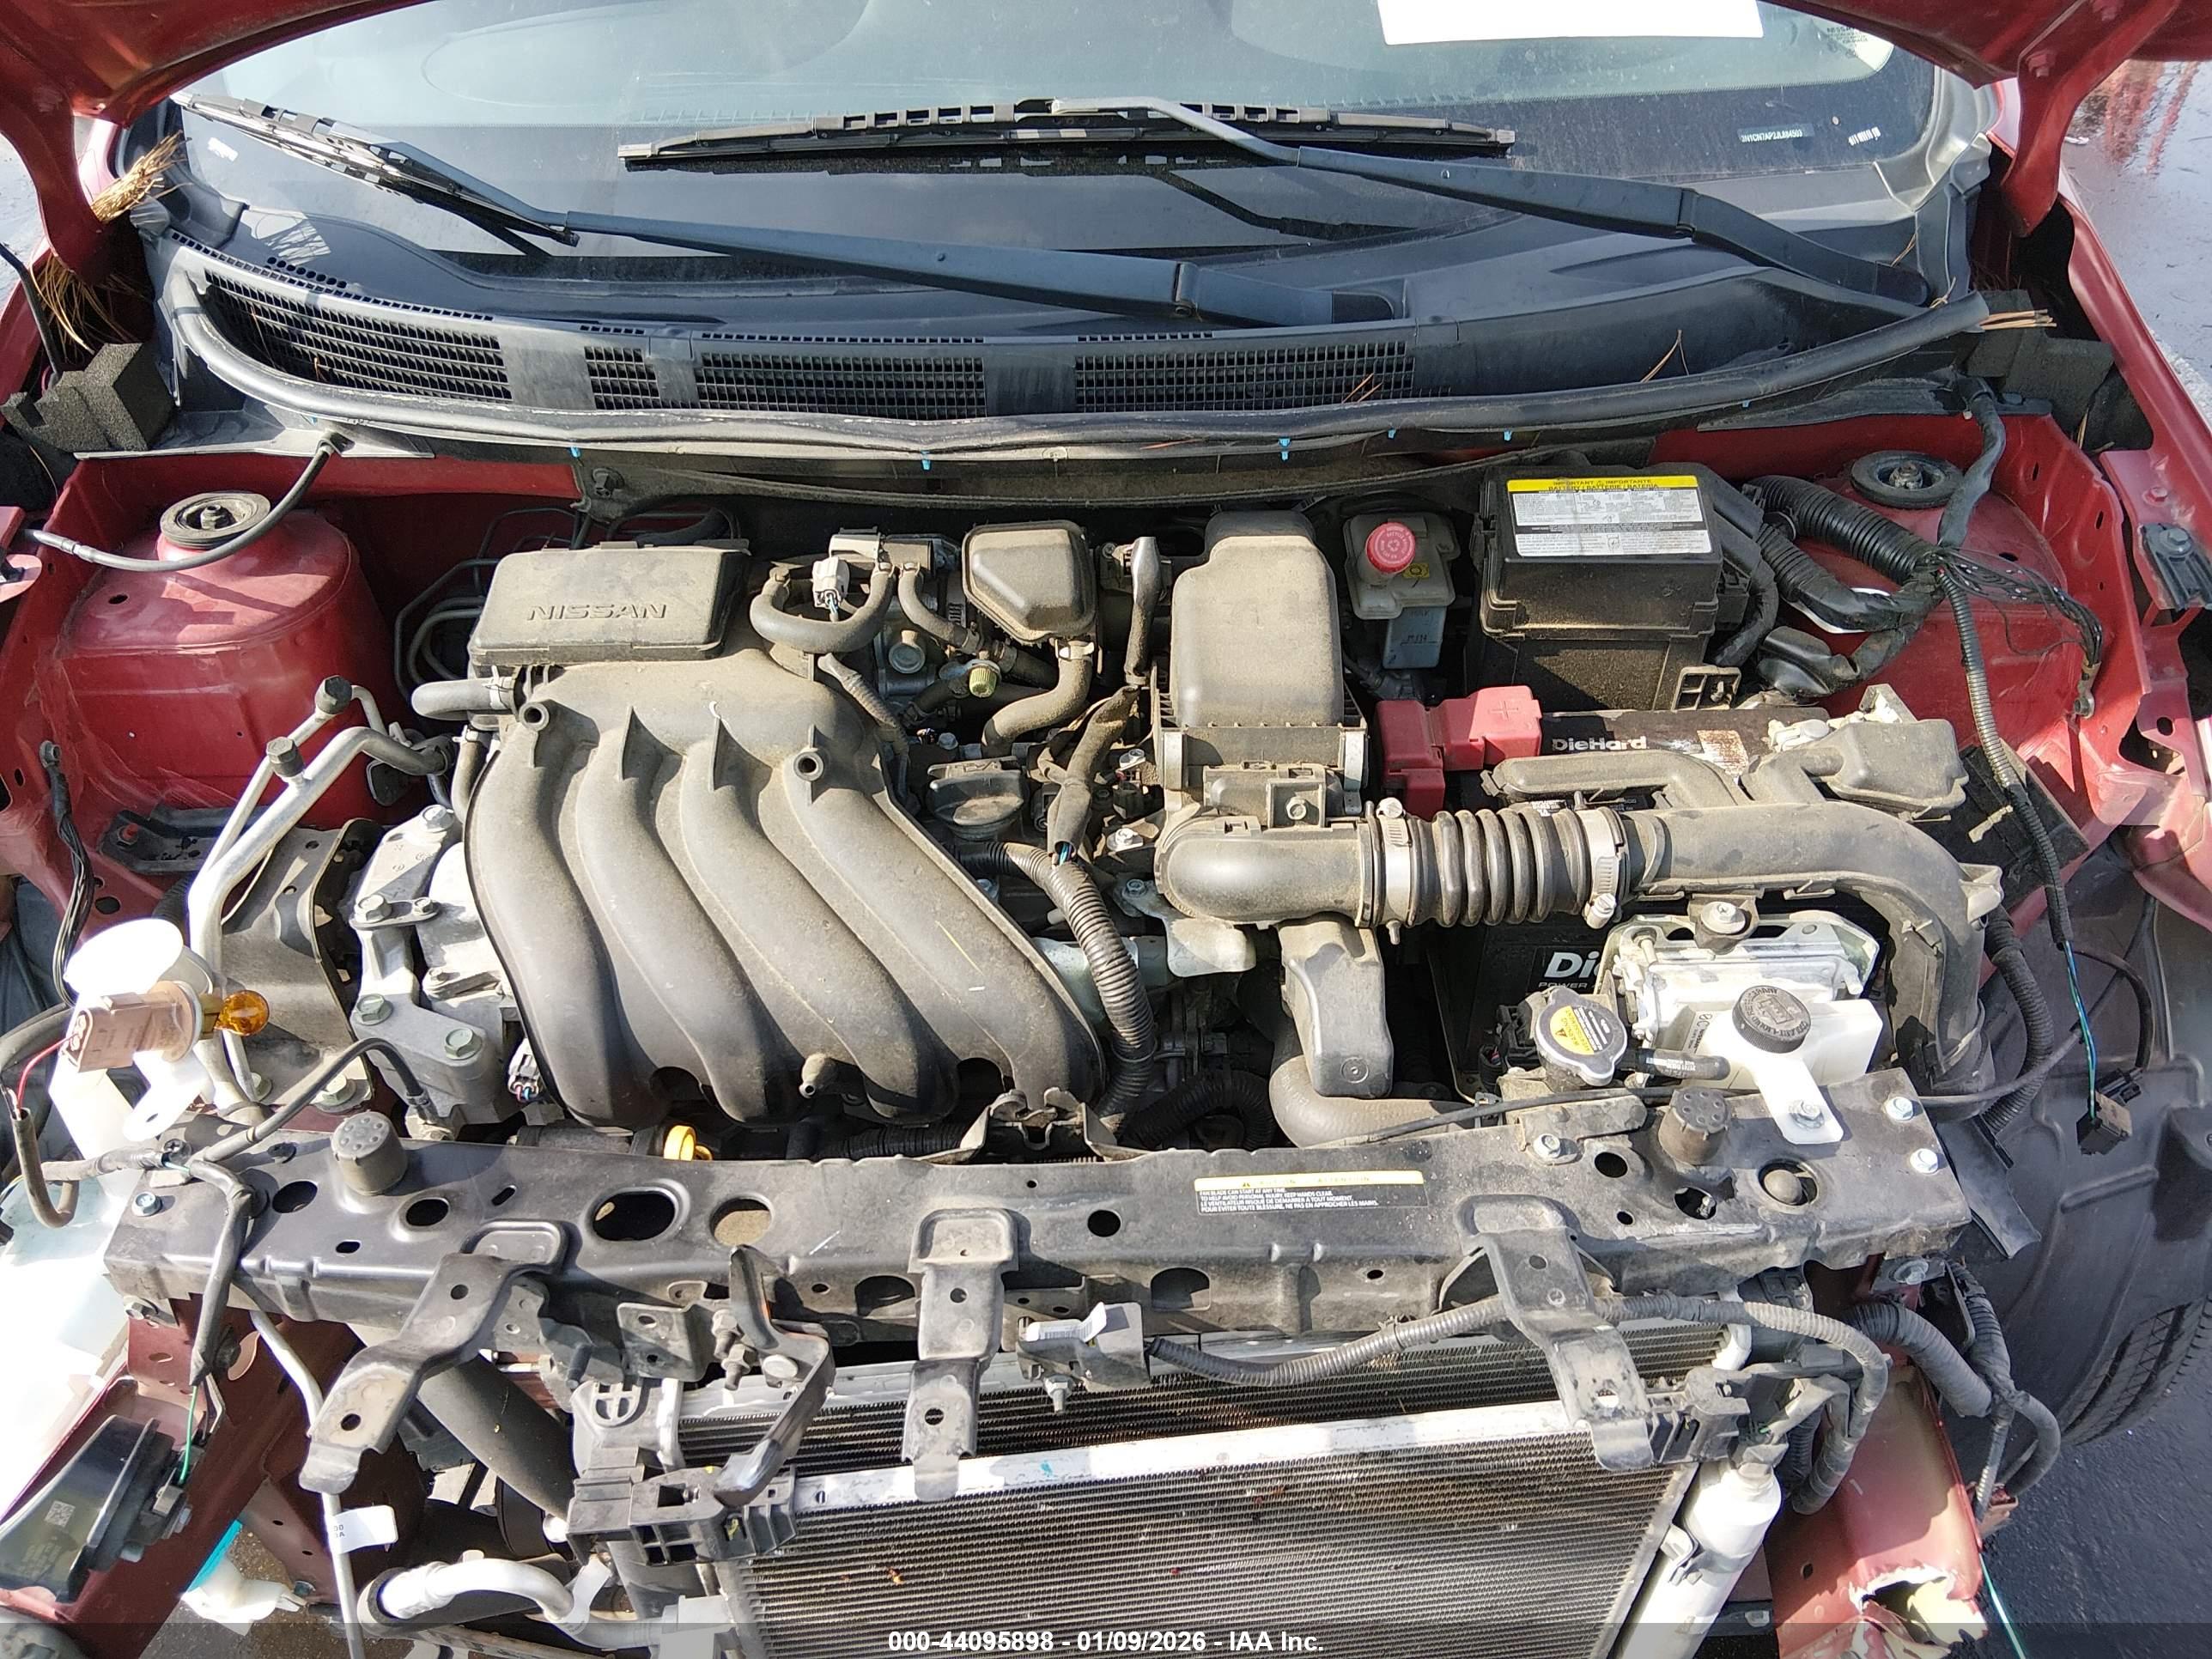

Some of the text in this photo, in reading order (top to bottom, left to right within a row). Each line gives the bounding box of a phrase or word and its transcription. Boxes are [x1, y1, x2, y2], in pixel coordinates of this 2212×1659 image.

[526, 604, 667, 621] NISSAN
[1552, 736, 1647, 751] DieHard
[1544, 951, 1600, 978] Di
